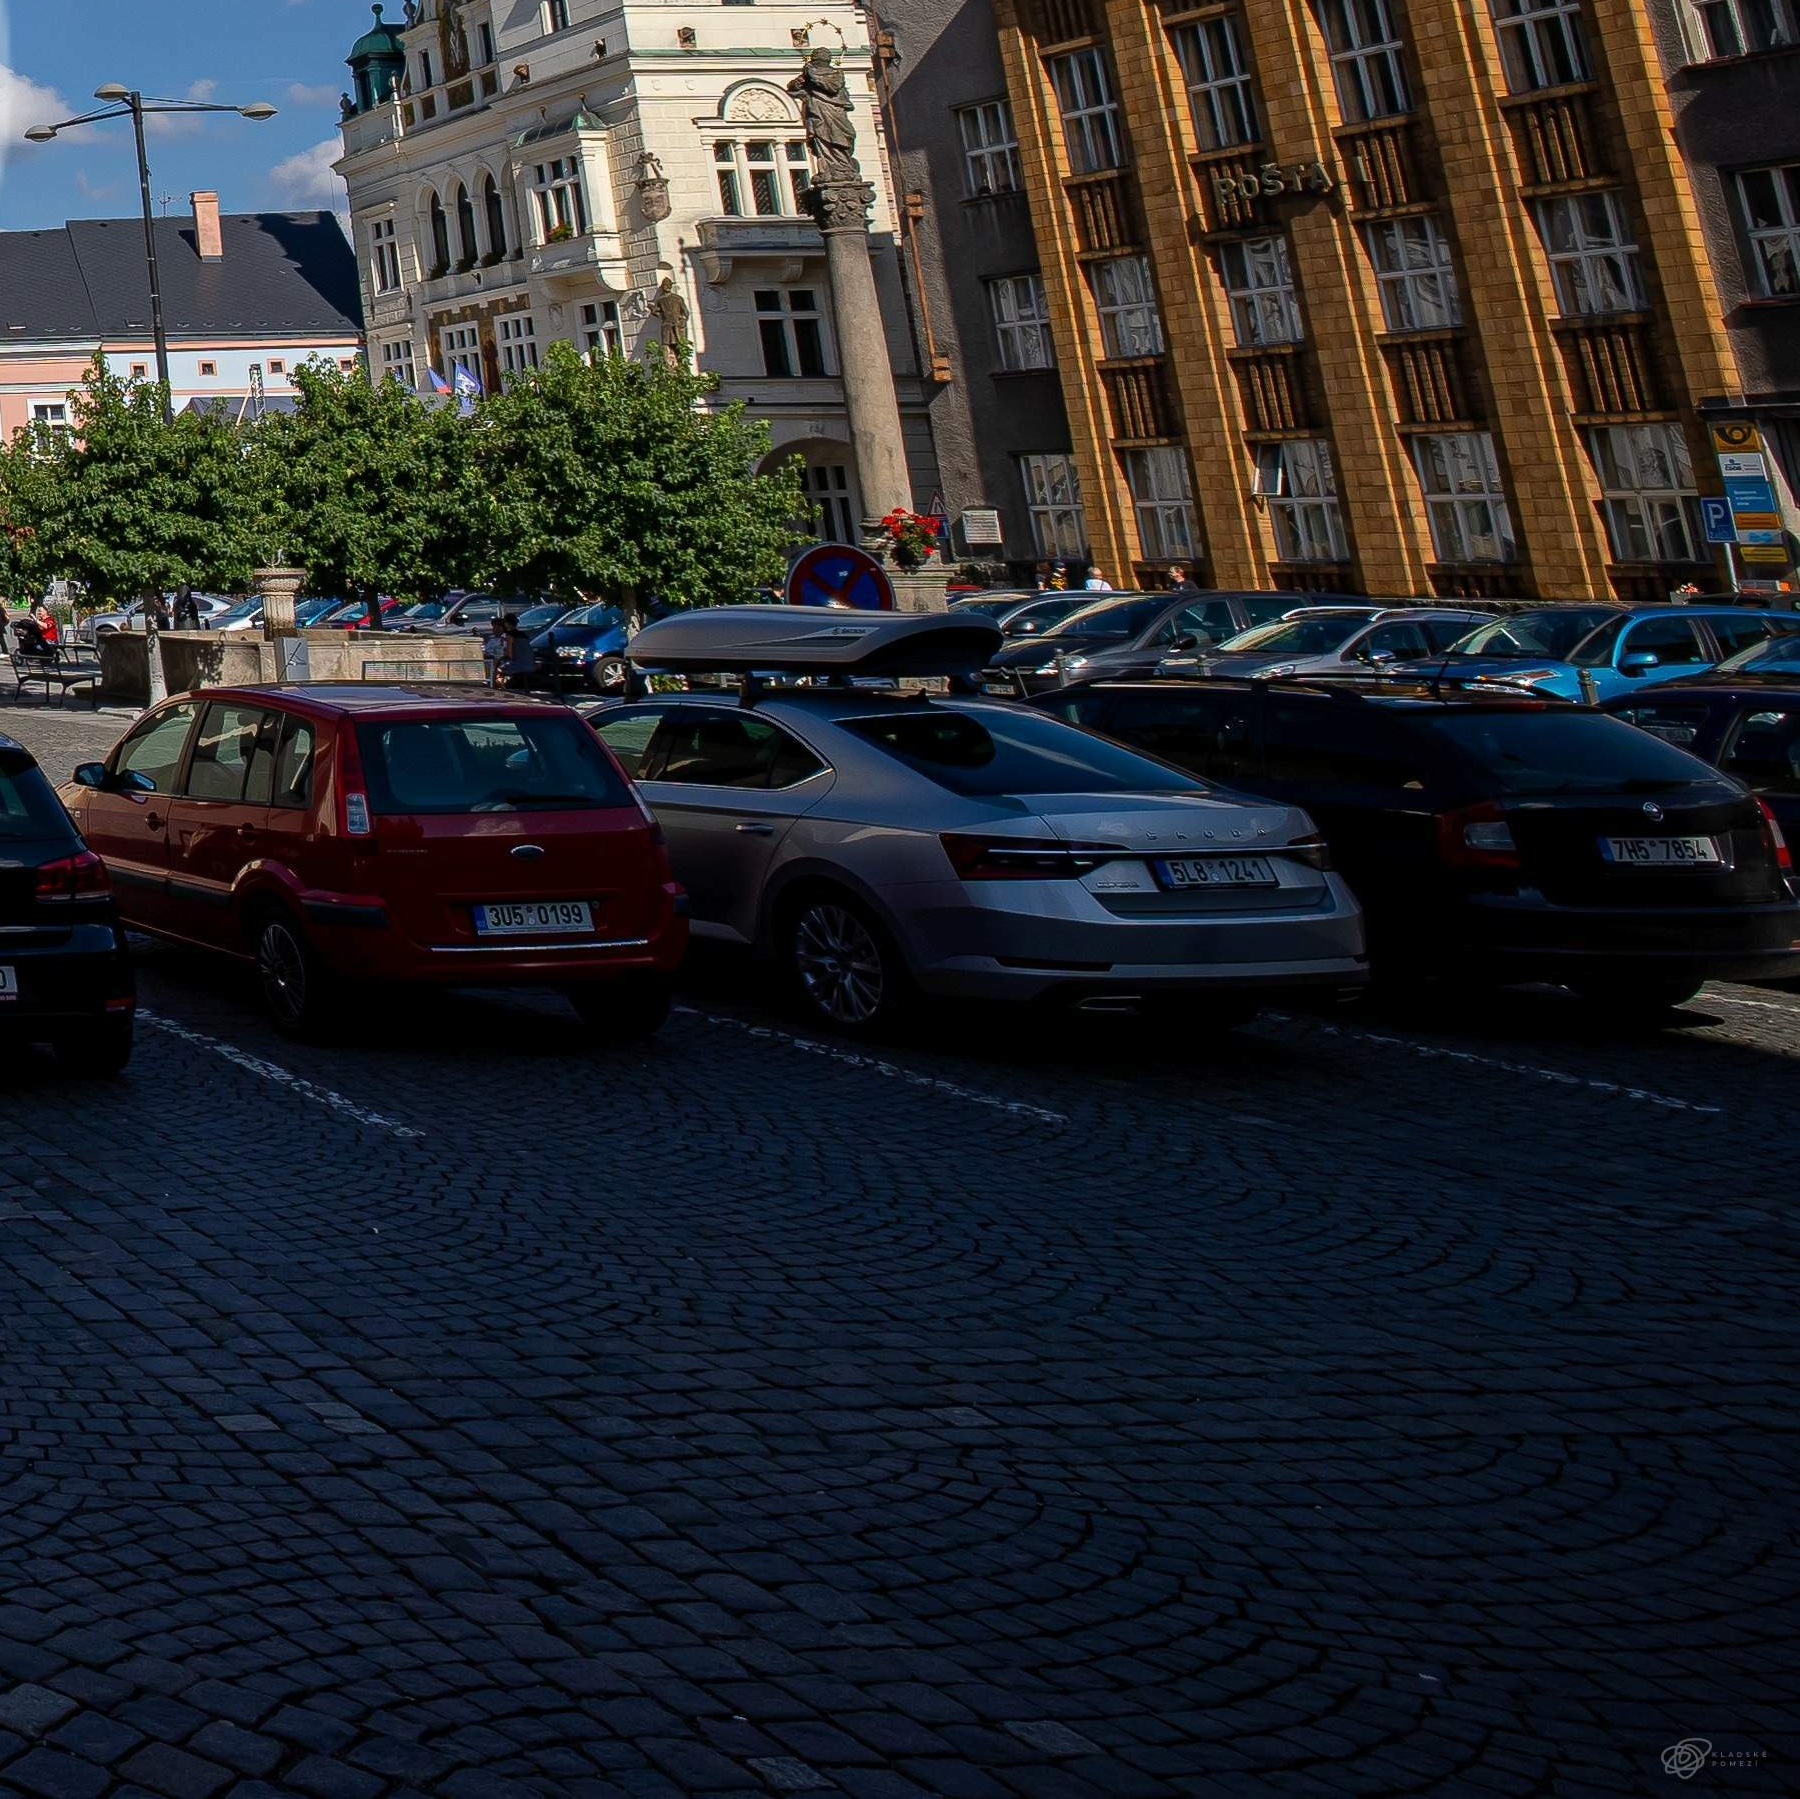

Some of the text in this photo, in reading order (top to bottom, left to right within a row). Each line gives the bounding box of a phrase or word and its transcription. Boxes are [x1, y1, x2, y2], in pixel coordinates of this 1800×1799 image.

[1707, 503, 1724, 529] P
[1612, 840, 1707, 860] 7H5 7854
[1170, 860, 1267, 883] 5L8 1241
[488, 907, 524, 927] 3U5
[537, 904, 584, 926] 0199
